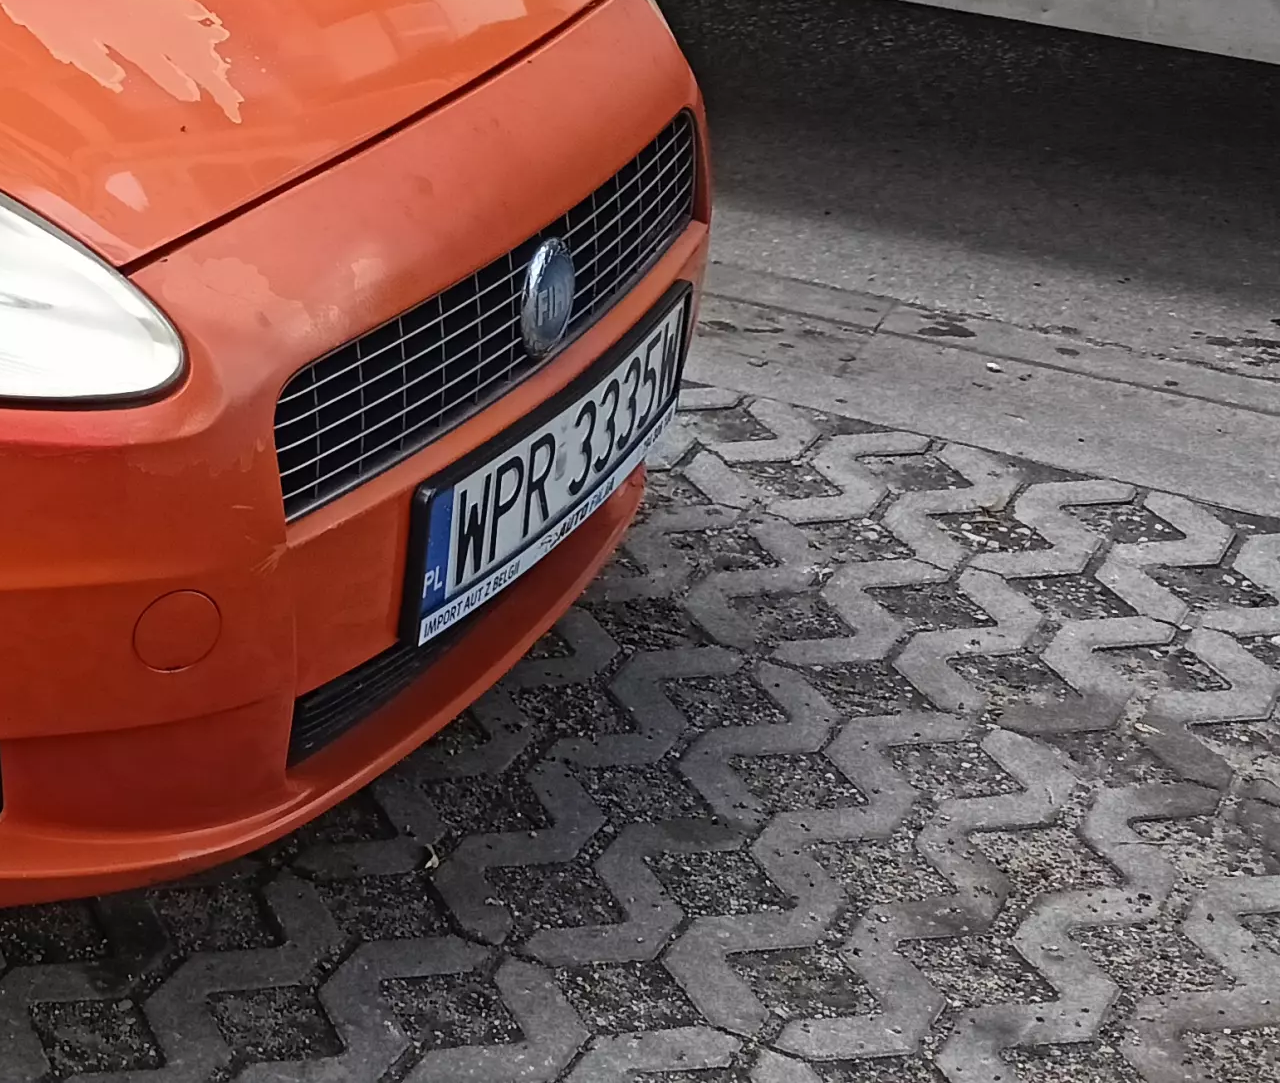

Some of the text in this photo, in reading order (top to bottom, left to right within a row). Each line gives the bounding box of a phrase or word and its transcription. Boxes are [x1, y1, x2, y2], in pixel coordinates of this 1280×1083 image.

[455, 307, 683, 586] WPR 3335W
[422, 569, 443, 599] PL
[424, 561, 520, 639] IMPORT AUT Z BELGII
